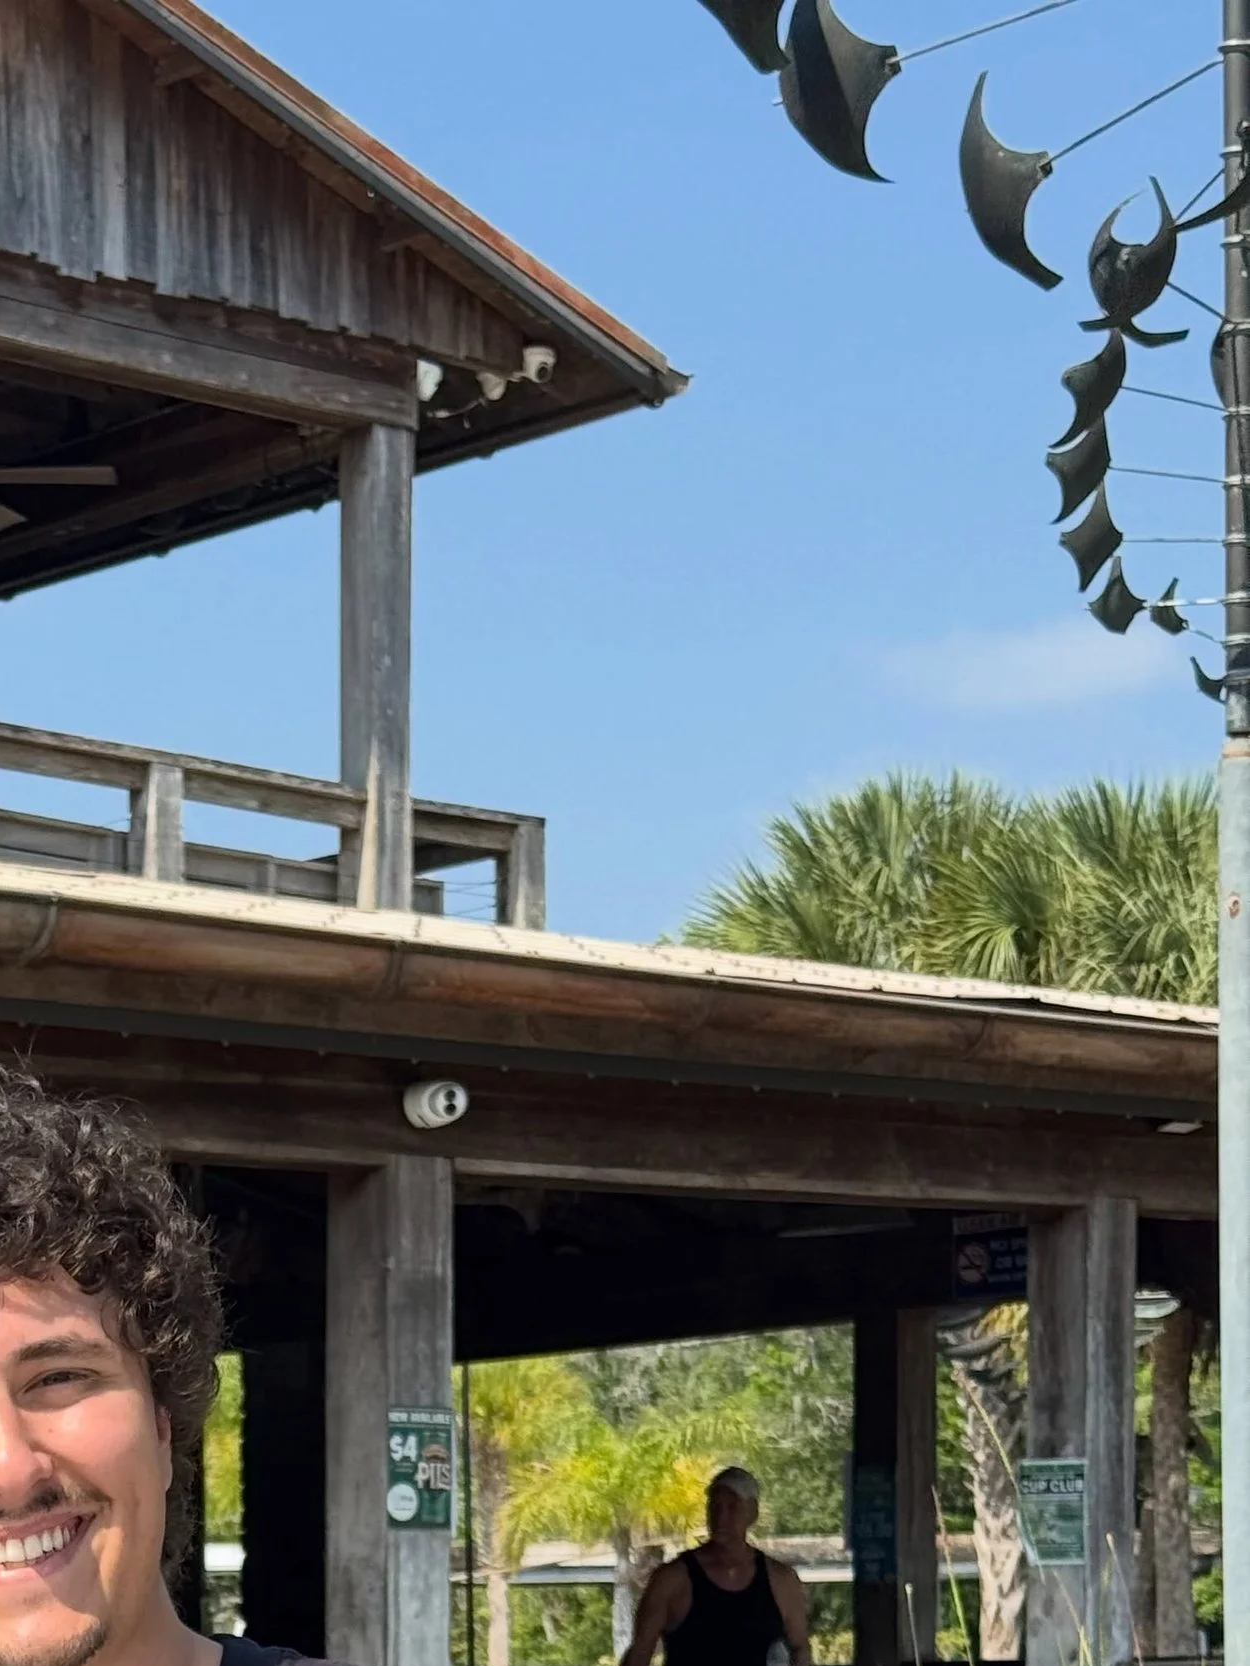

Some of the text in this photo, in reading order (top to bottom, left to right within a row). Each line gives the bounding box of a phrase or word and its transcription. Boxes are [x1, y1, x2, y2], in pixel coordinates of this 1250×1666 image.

[389, 1433, 418, 1461] $4
[414, 1462, 451, 1490] PILS
[1049, 1479, 1083, 1493] CLUB
